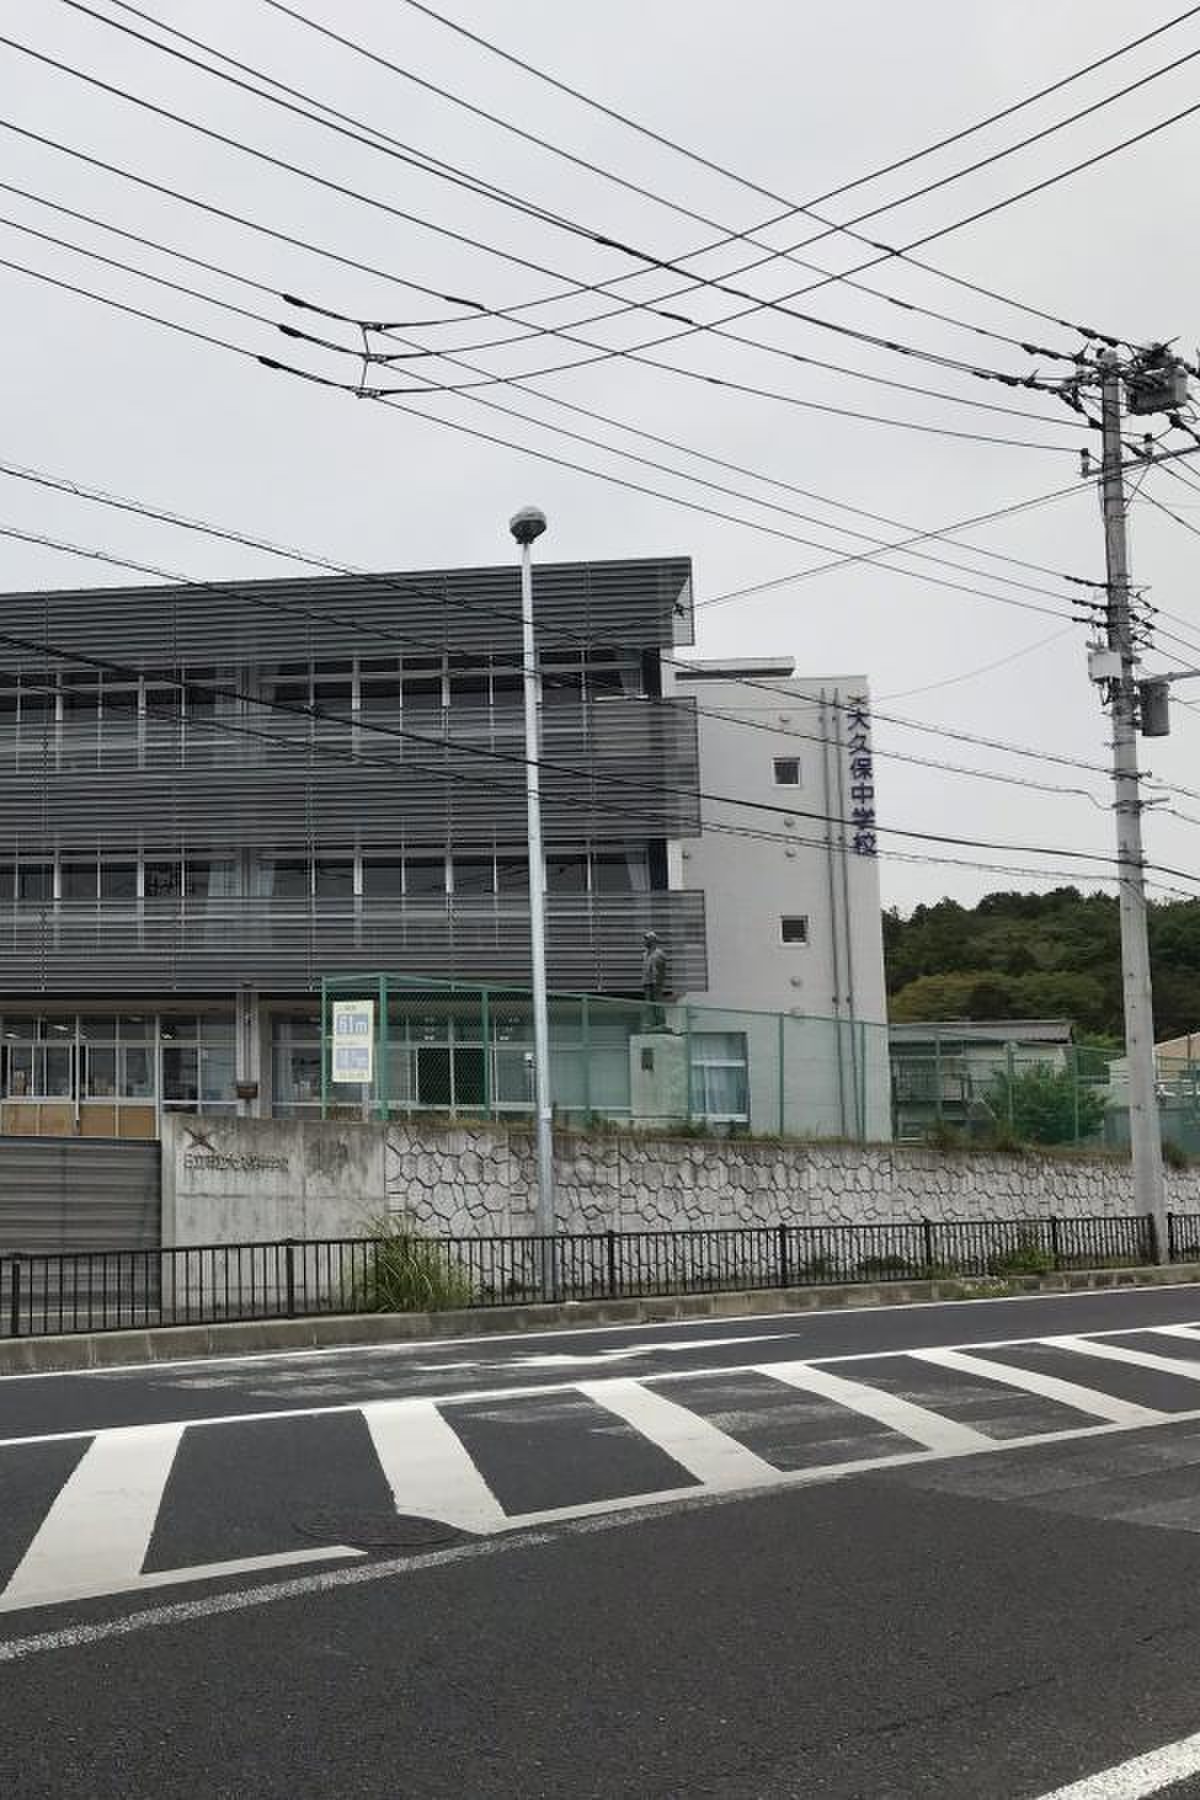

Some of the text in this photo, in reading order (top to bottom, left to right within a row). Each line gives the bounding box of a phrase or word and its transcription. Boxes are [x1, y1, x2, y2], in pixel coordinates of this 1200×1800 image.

[847, 708, 877, 856] 大久保中学校
